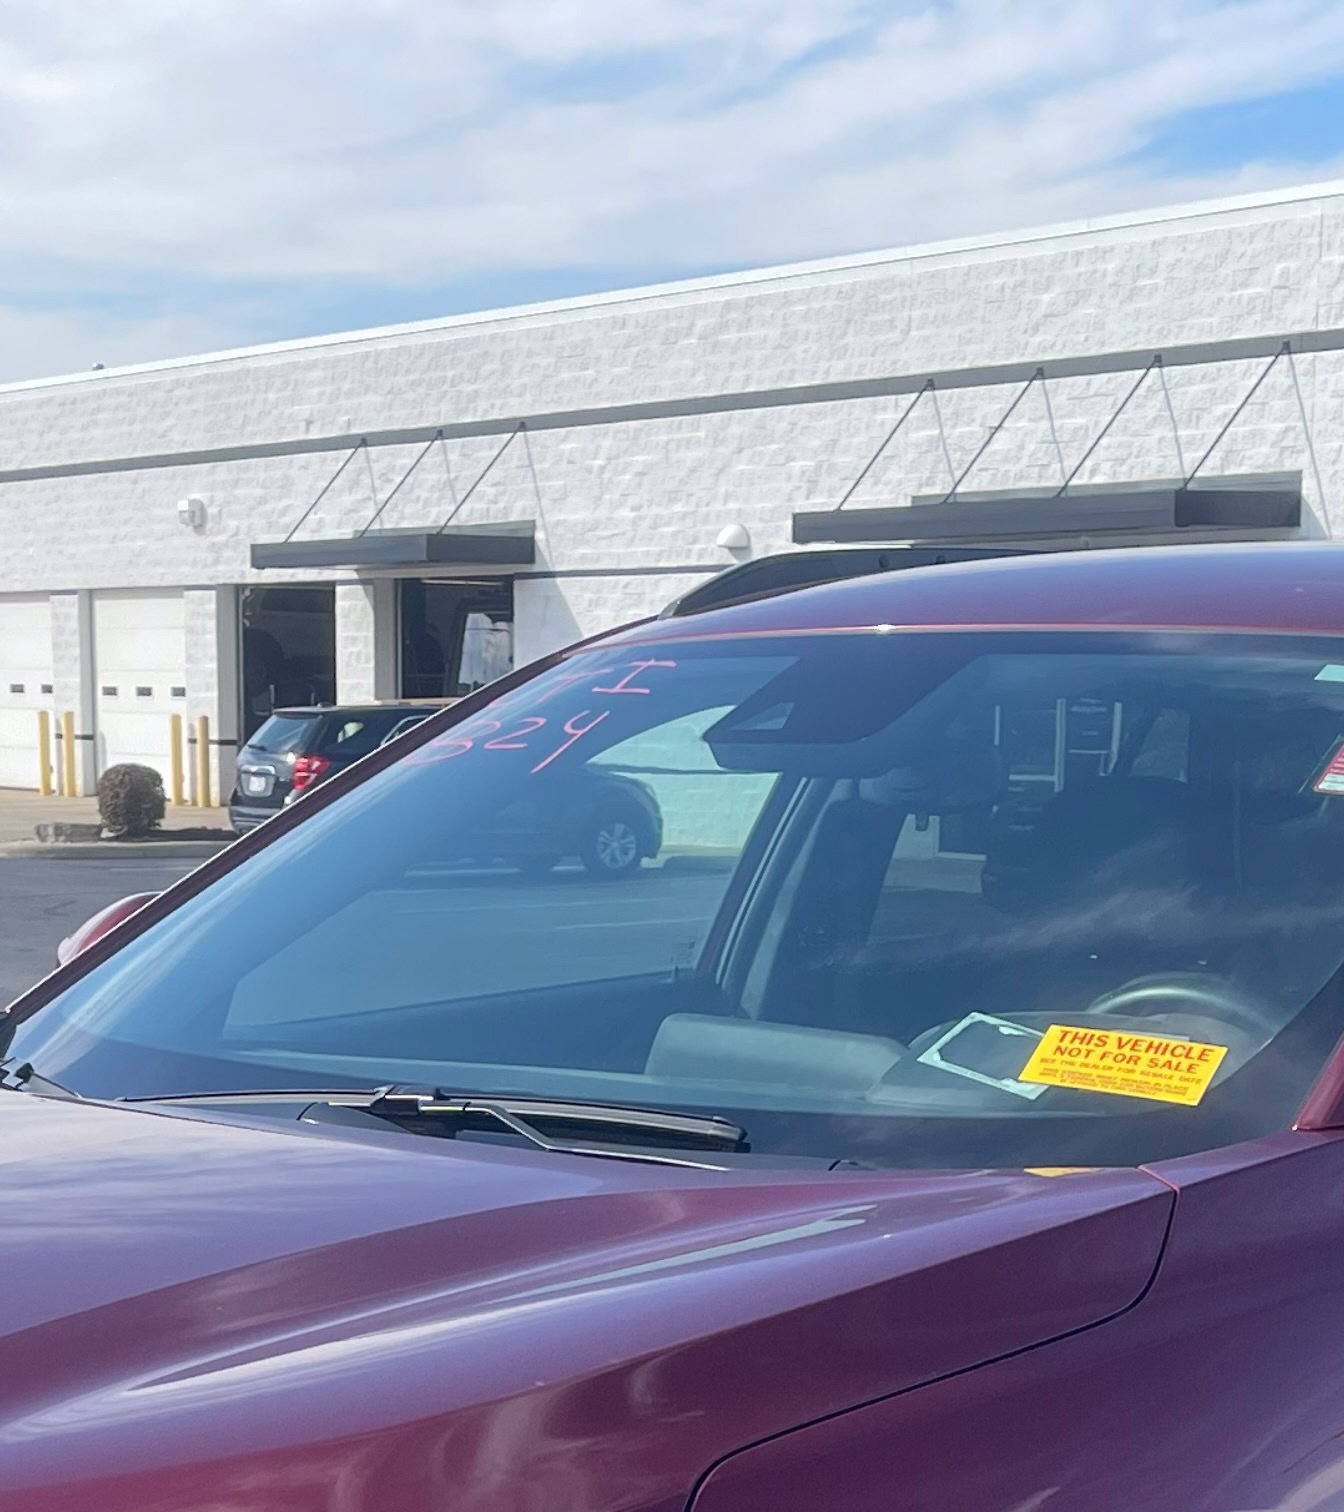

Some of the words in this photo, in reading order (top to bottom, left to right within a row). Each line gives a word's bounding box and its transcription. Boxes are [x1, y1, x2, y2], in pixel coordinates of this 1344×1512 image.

[1053, 1045, 1092, 1059] NOT
[1100, 1051, 1142, 1065] FOR
[1147, 1057, 1200, 1075] SALE
[1058, 1029, 1109, 1048] THIS
[1115, 1036, 1215, 1063] VEHICLE
